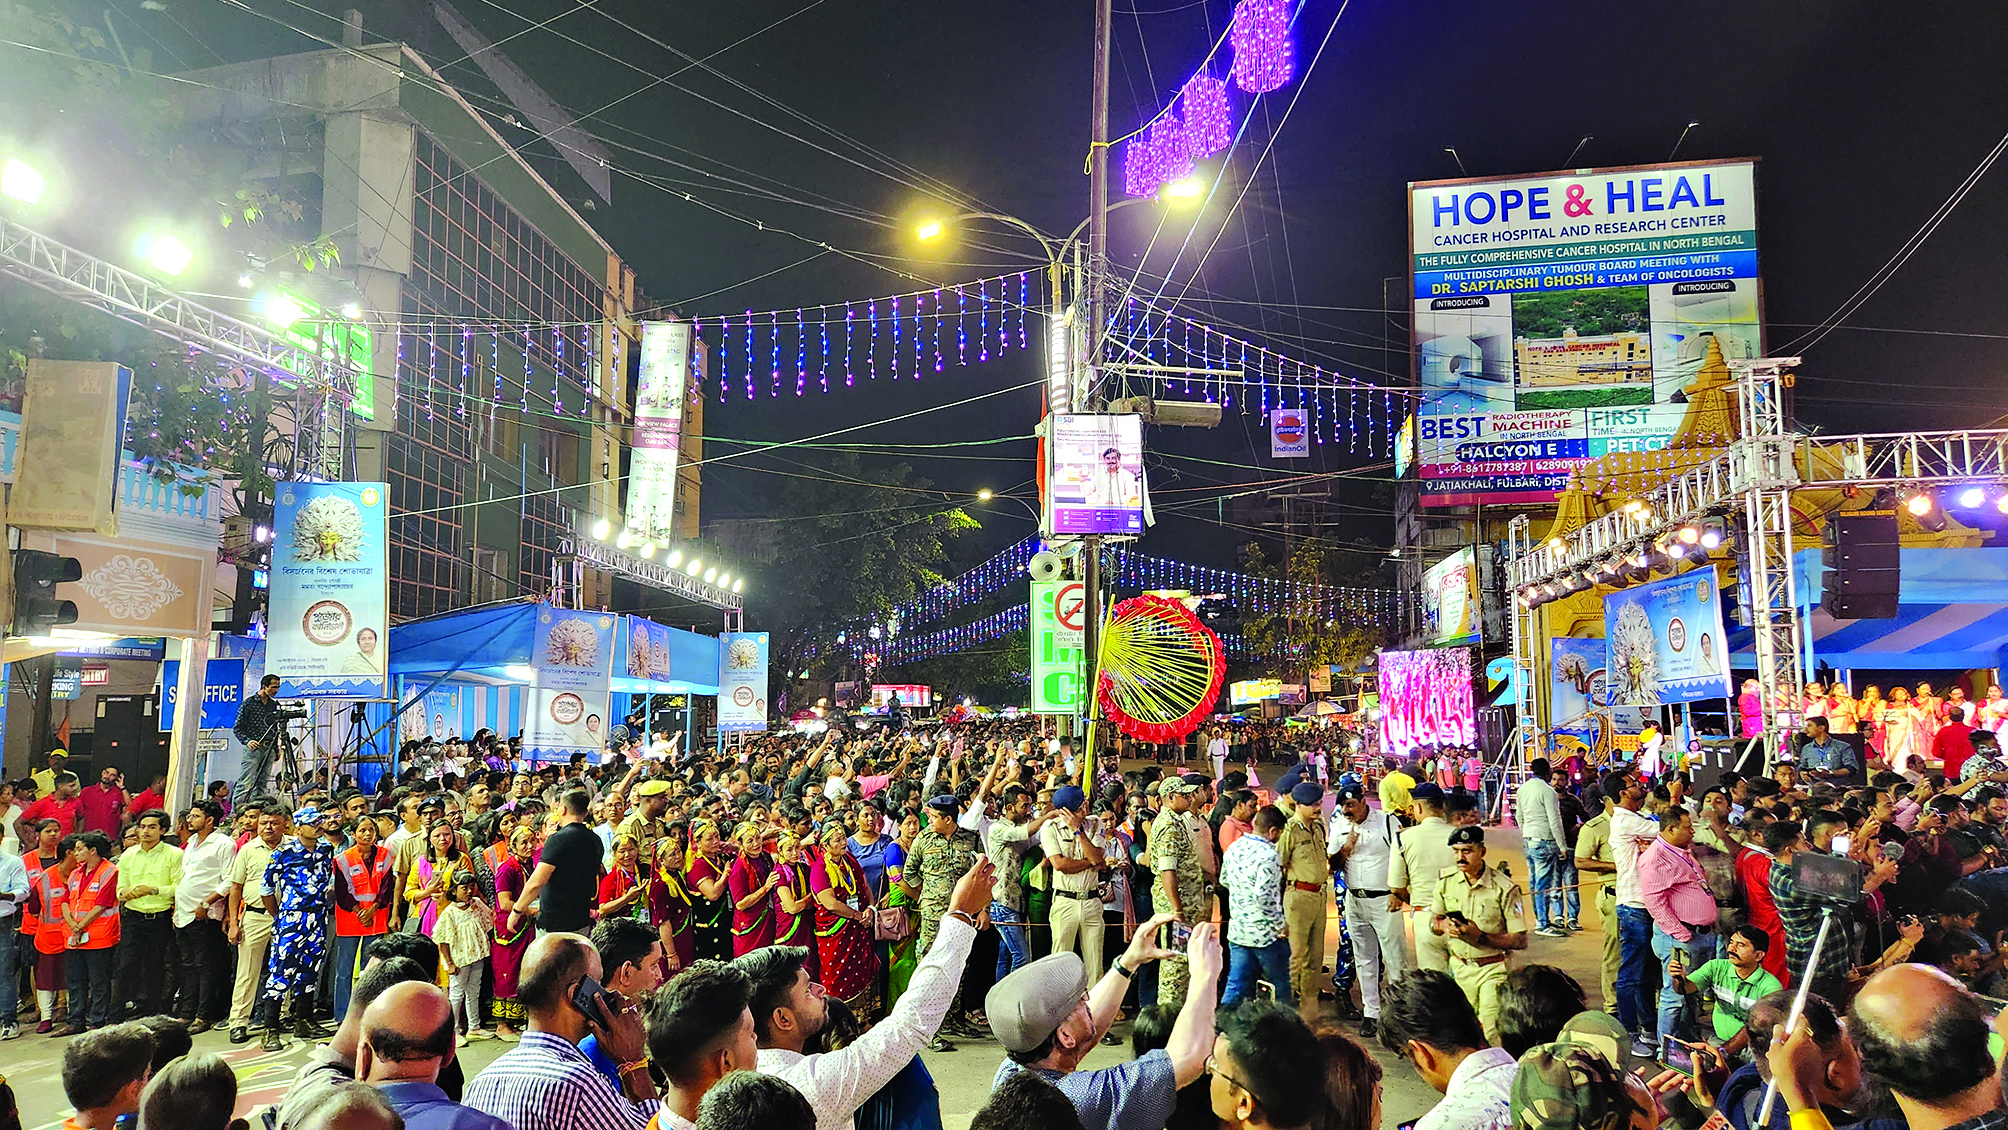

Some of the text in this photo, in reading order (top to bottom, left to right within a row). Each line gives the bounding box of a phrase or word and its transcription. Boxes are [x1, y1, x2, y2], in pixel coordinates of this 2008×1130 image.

[1432, 174, 1725, 228] HOPE & HEAL
[1434, 214, 1726, 247] CANCER HOSPITAL AND RESEARCH CENTER
[1420, 234, 1744, 267] THE FULLY COMPREHENSIVE CANCER HOSPITAL IN NORTH BENGAL
[1444, 254, 1719, 281] MULTIDISCIPLINARY TUMOUR BOARD MEETING WITH
[1431, 267, 1735, 295] DR. SAPTARSHI GHOSH & TEAM OF ONCOLOGISTS
[1678, 282, 1730, 292] INTRODUCING
[1436, 297, 1484, 308] INTRODUCING
[1492, 410, 1572, 421] RADIOTHERAPY
[1591, 408, 1651, 426] FIRST
[1421, 417, 1486, 439] BEST
[1492, 419, 1572, 432] MACHINE
[1592, 428, 1615, 436] TIME
[1500, 432, 1508, 440] IN
[1537, 430, 1567, 438] BENGAL
[1461, 443, 1558, 459] HALCYON E
